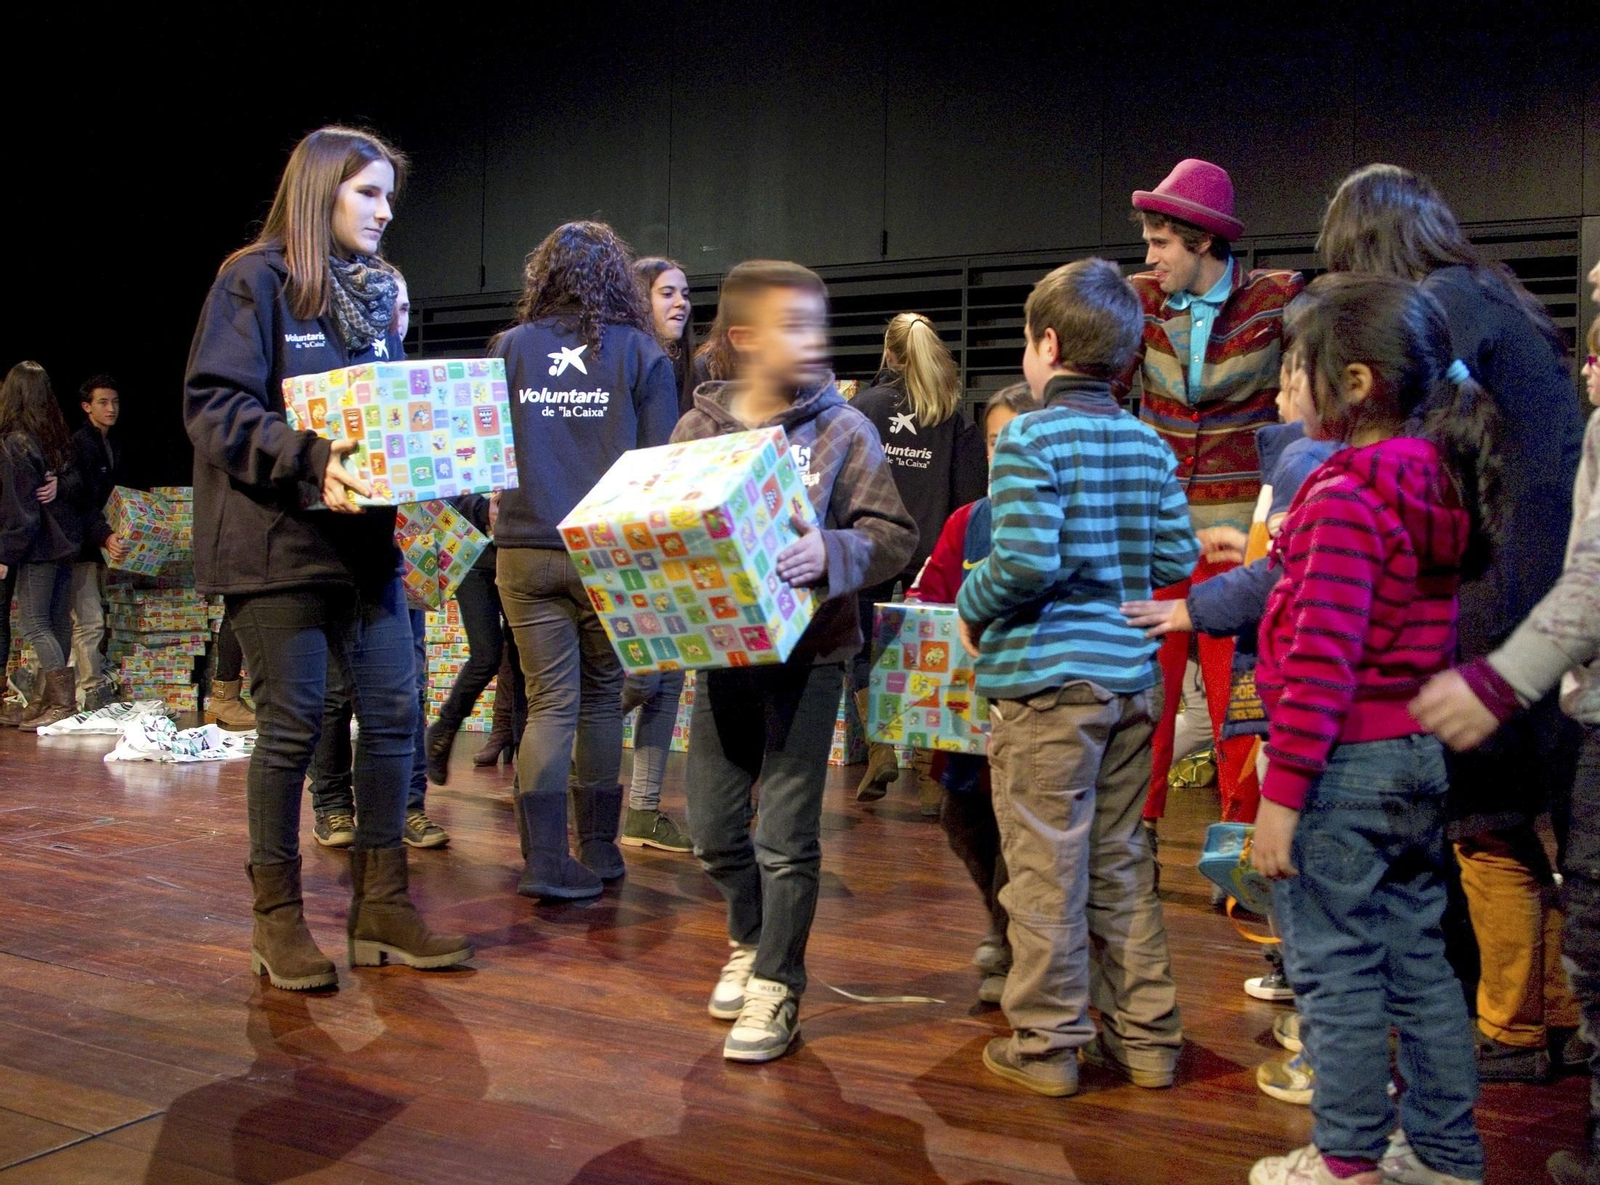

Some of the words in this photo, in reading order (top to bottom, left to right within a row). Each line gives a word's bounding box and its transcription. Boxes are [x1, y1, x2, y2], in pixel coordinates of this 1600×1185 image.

[285, 332, 325, 342] Voluntaris
[519, 387, 610, 404] Voluntaris
[541, 406, 555, 417] de
